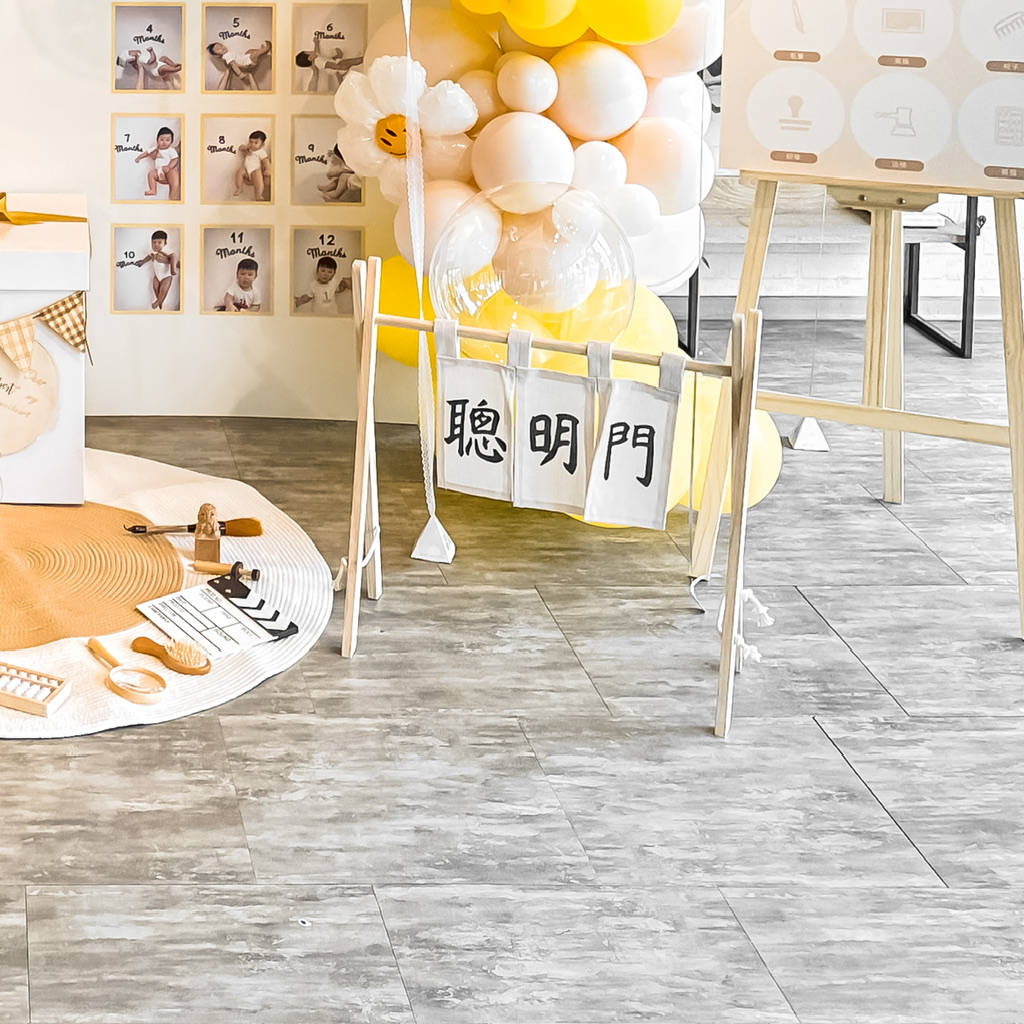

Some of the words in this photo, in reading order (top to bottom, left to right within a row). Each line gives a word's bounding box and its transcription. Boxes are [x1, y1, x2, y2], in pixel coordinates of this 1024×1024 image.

[232, 17, 240, 28] 5
[326, 23, 333, 32] 6
[146, 24, 153, 34] 4
[218, 29, 251, 40] Months
[133, 34, 165, 45] Months
[314, 30, 345, 40] Months
[124, 133, 131, 143] 7
[219, 135, 226, 144] 8
[207, 144, 236, 154] Months
[307, 143, 314, 153] 9
[295, 154, 328, 165] Months
[230, 232, 245, 244] 11
[318, 234, 335, 246] 12
[124, 250, 135, 259] 10
[215, 245, 255, 259] Months
[306, 247, 347, 259] Months
[444, 398, 656, 488] 聰明門
